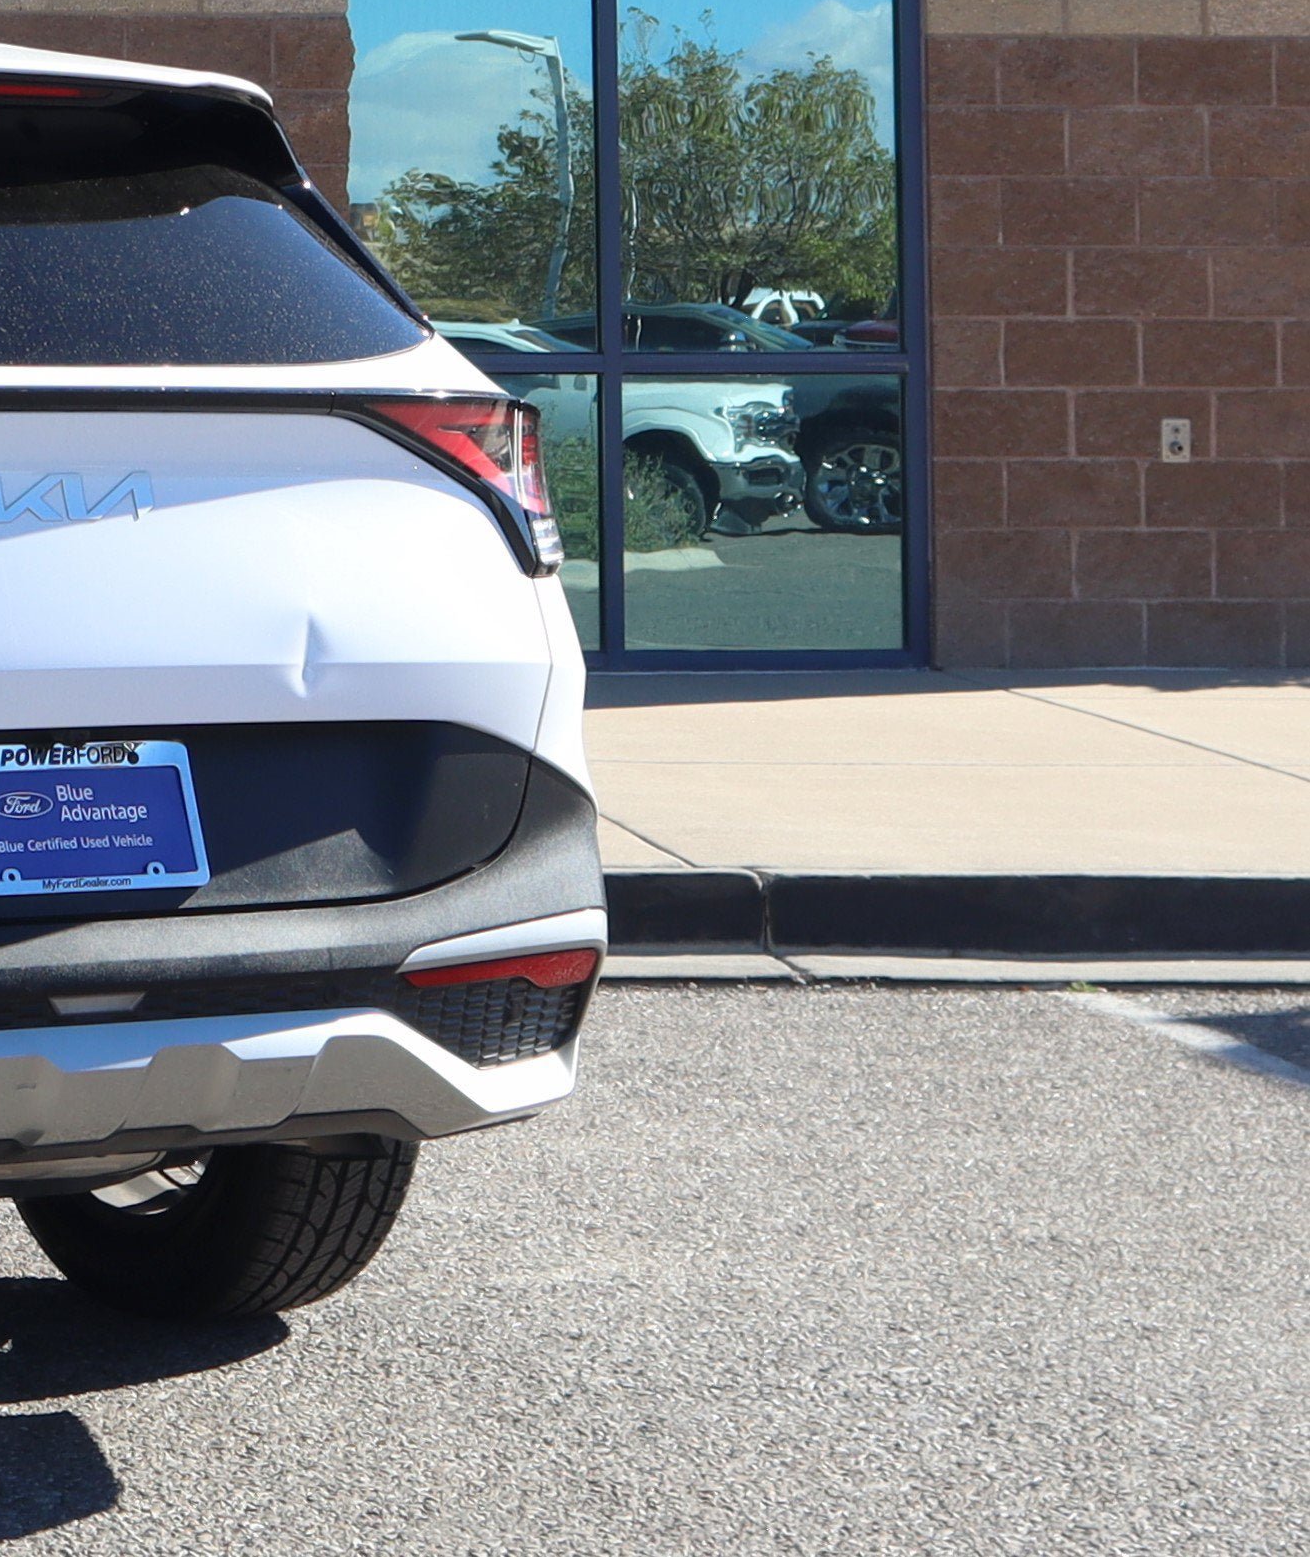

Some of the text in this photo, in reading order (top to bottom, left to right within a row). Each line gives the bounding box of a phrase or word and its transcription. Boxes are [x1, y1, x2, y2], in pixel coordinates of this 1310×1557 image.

[55, 784, 94, 802] Blue
[3, 795, 42, 814] Ford
[60, 803, 148, 823] Advantage
[27, 837, 78, 852] Certified
[80, 835, 110, 849] Used
[112, 833, 154, 848] Vehicle
